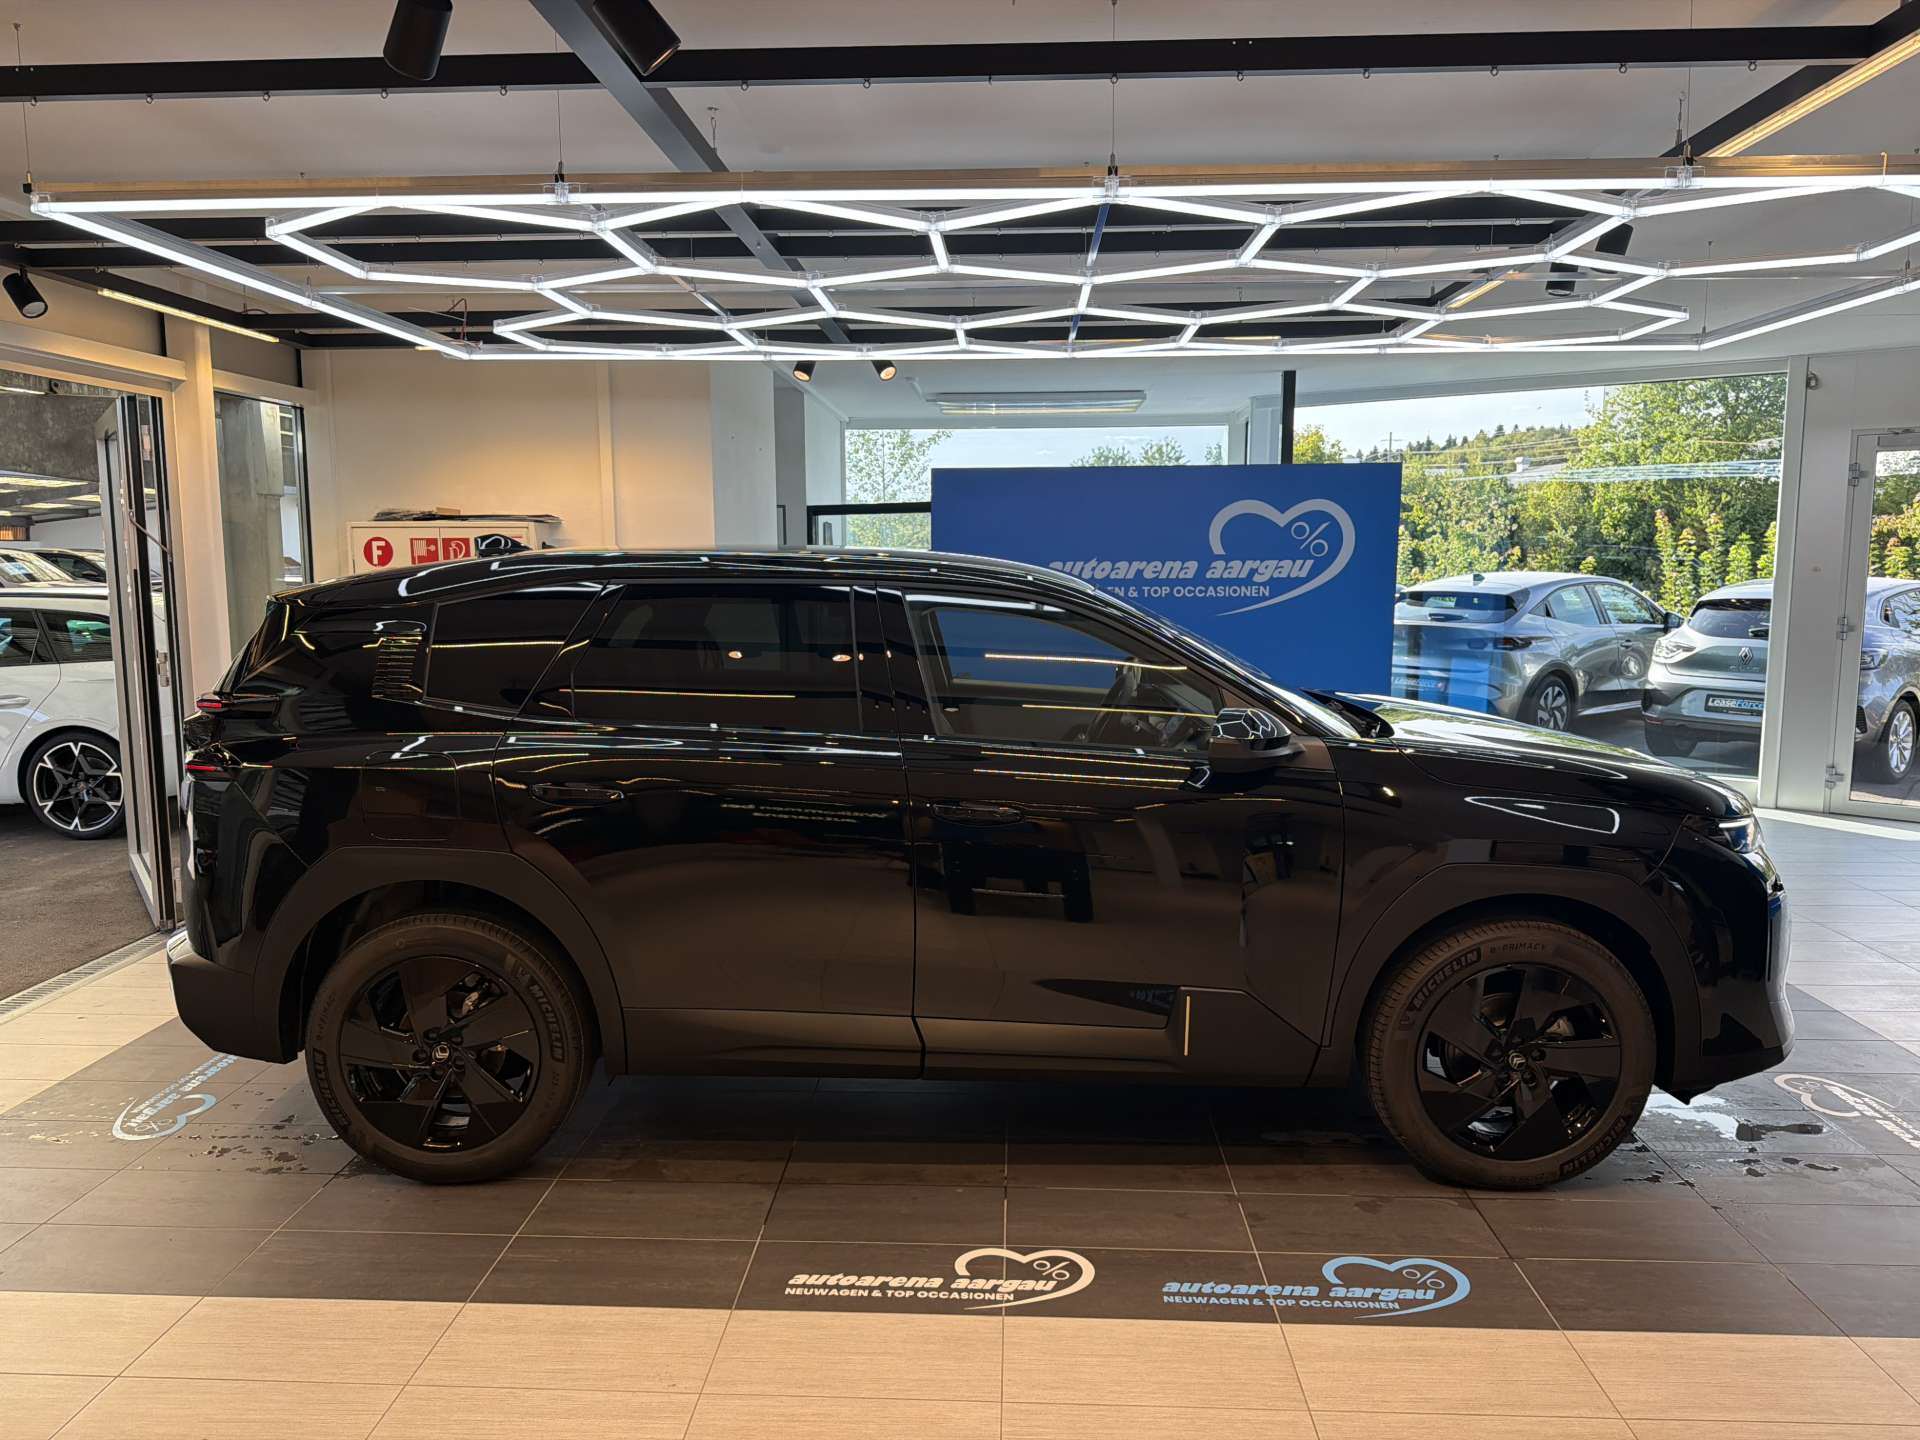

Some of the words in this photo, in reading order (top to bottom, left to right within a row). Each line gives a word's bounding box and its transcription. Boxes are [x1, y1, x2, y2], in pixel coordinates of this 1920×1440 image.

[371, 540, 386, 564] F
[1206, 559, 1314, 582] aargau
[1128, 586, 1138, 597] &
[1142, 586, 1170, 597] TOP
[1173, 586, 1270, 597] OCCASIONEN
[788, 1273, 943, 1289] autoarena
[951, 1276, 1057, 1293] aargau
[1162, 1281, 1319, 1297] autoarena
[1330, 1286, 1435, 1300] aargau
[785, 1287, 869, 1297] NEUWAGEN
[885, 1290, 914, 1298] TOP
[917, 1290, 1014, 1300] OCCASIONEN
[1163, 1295, 1249, 1305] NEUWAGEN
[1267, 1299, 1296, 1307] TOP
[1300, 1299, 1400, 1309] OCCASIONEN
